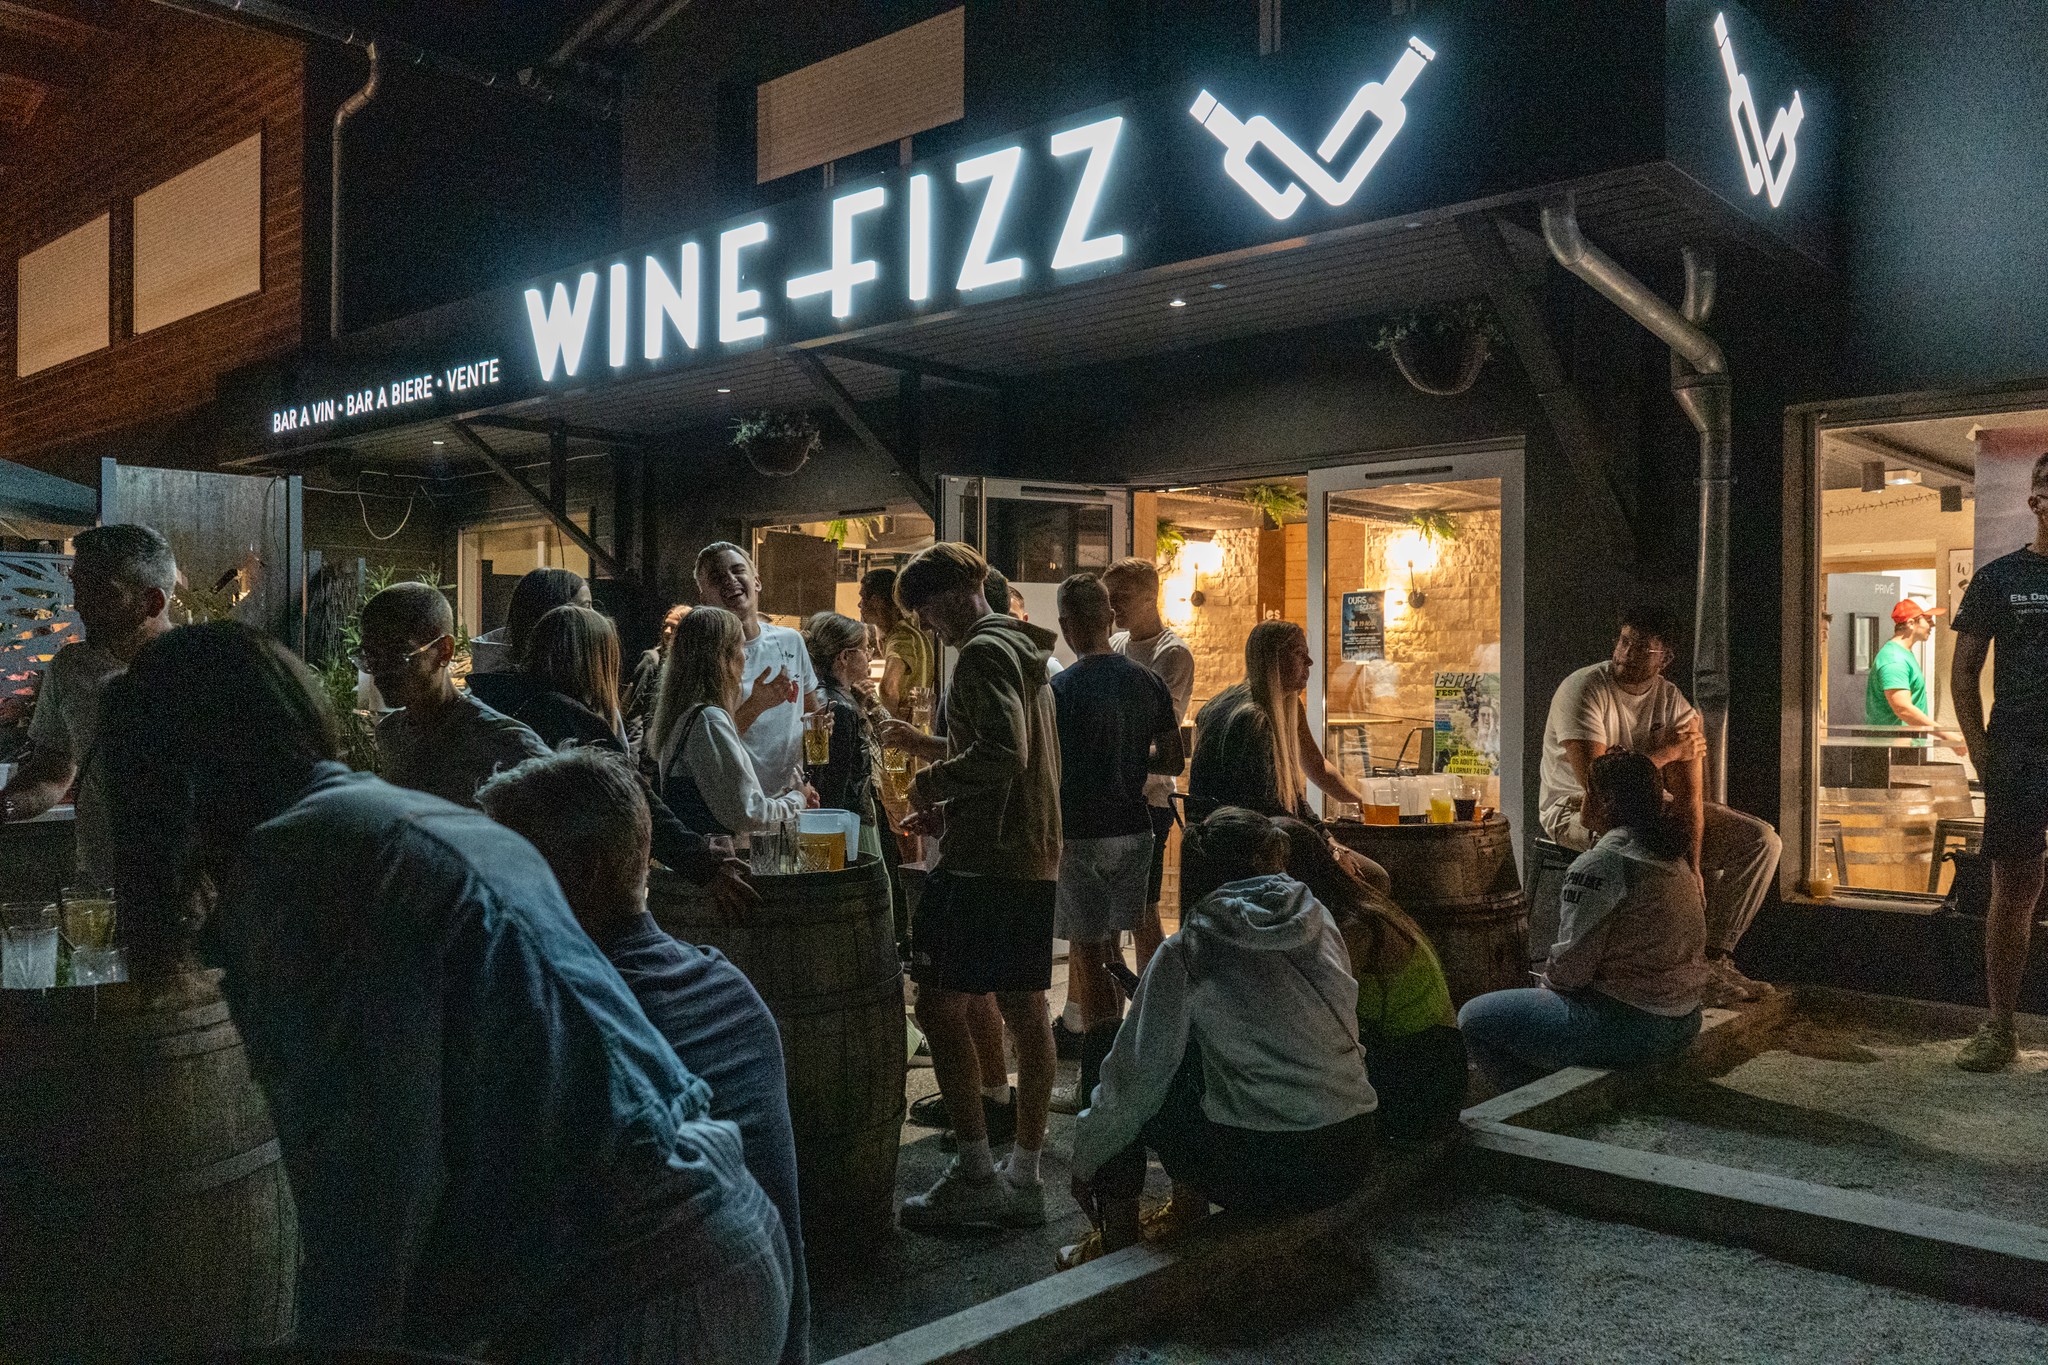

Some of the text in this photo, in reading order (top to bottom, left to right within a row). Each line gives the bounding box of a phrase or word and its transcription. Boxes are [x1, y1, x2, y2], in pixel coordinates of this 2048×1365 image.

[524, 116, 1124, 382] WINE FIZZ
[273, 358, 500, 433] BAR A VIN BAR A BIERE VENTE
[1874, 582, 1895, 595] PRIVÉ
[1348, 596, 1367, 604] OURS
[1262, 603, 1280, 620] les
